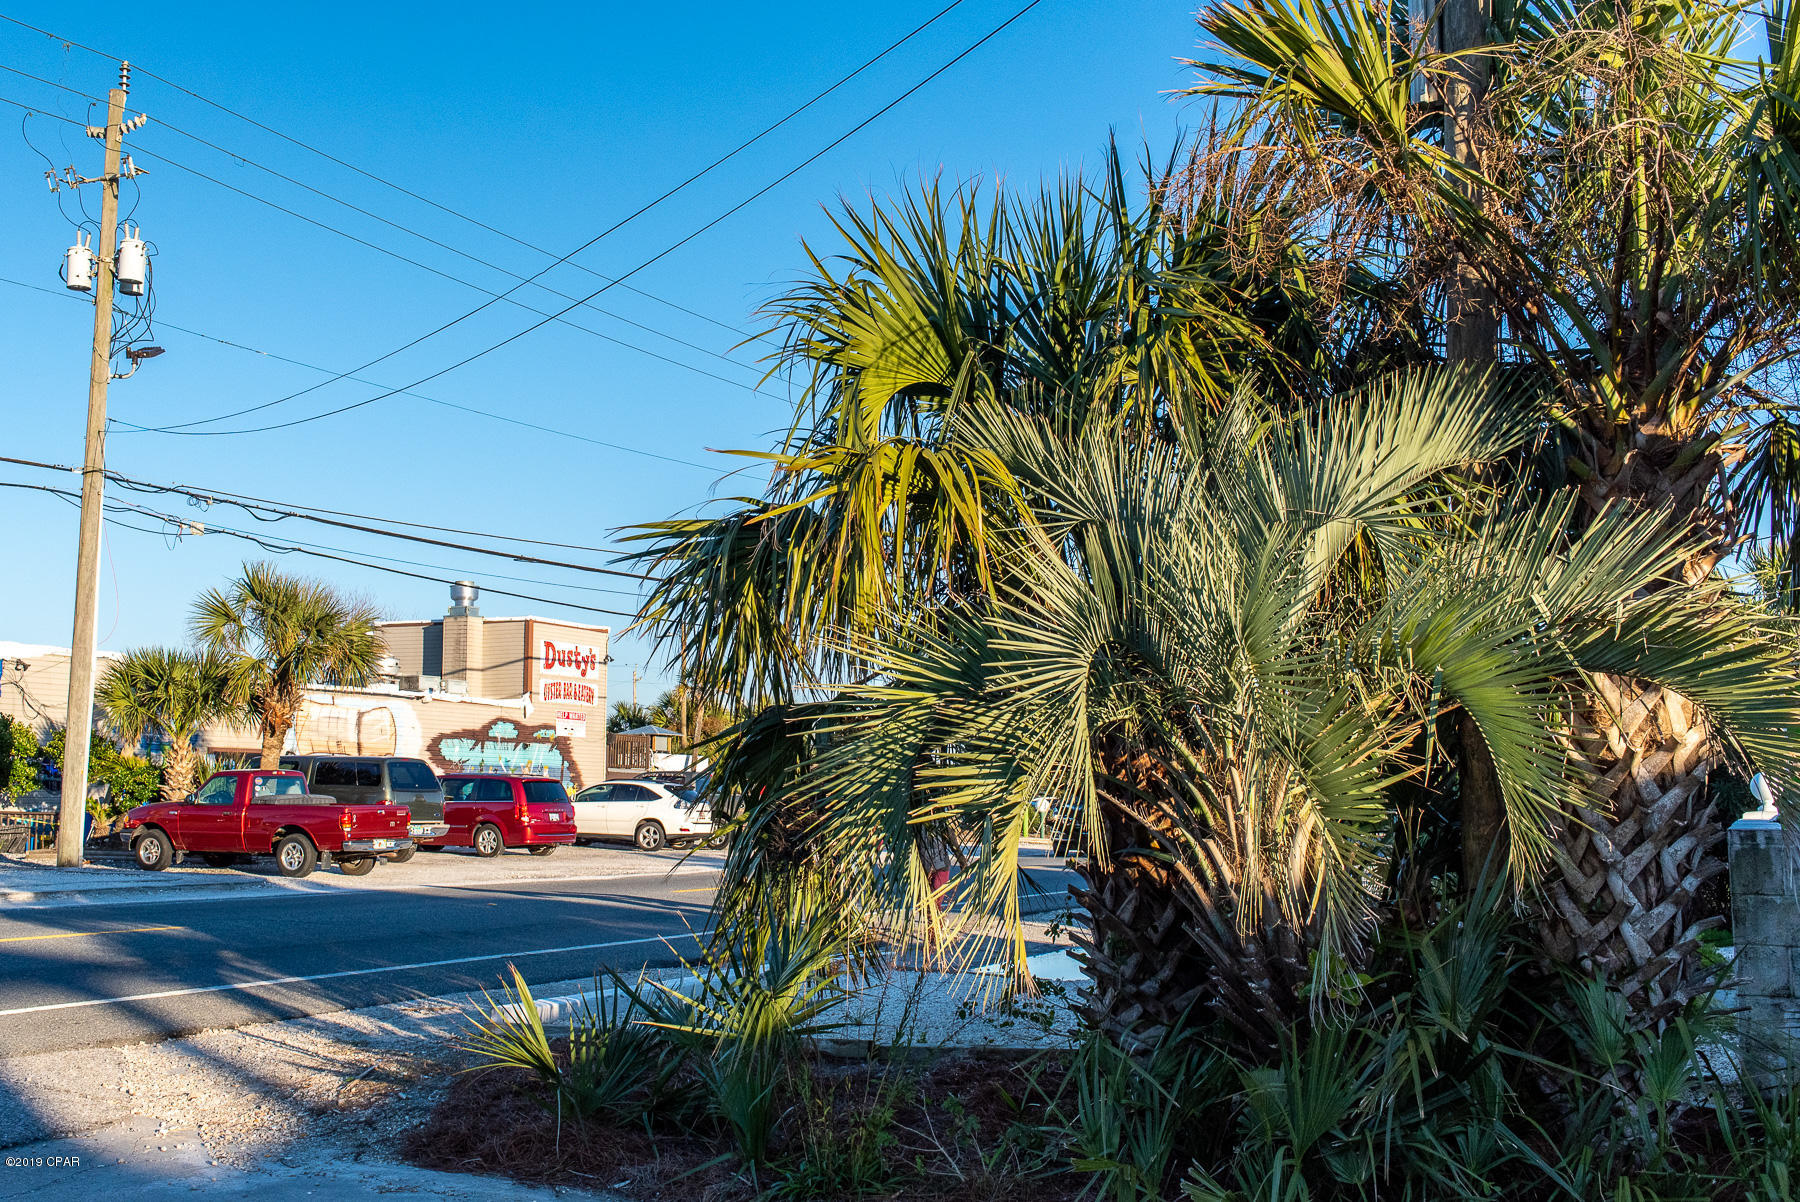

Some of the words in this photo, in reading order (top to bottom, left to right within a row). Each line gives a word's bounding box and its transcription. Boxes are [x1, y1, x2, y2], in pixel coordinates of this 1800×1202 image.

[543, 640, 597, 677] Dusty's
[543, 681, 561, 701] OYSTER
[563, 682, 573, 700] BAR
[578, 683, 595, 705] EATERY
